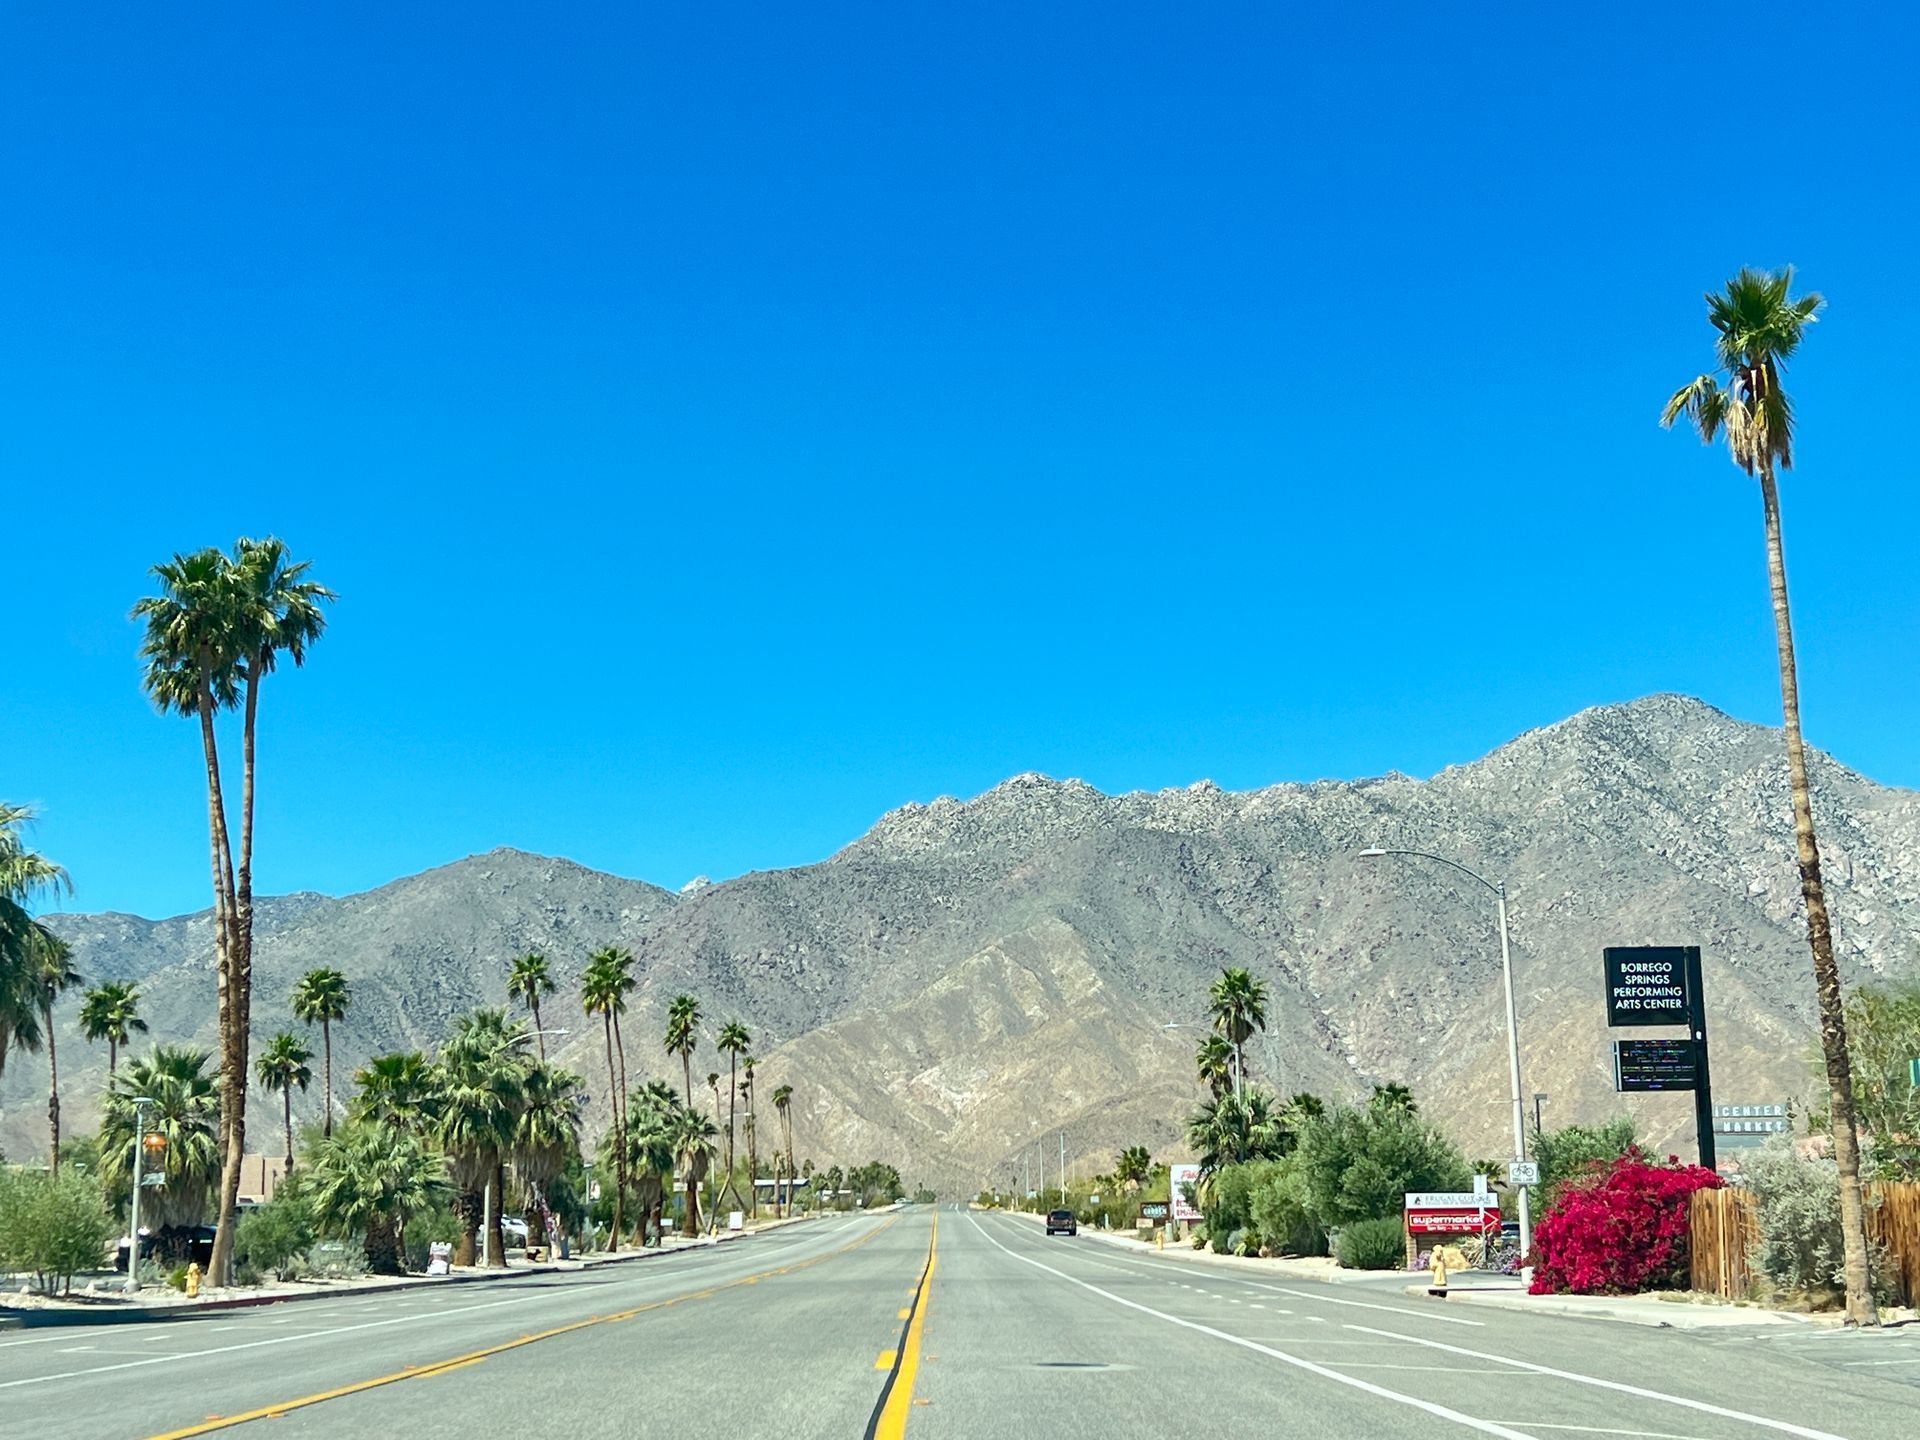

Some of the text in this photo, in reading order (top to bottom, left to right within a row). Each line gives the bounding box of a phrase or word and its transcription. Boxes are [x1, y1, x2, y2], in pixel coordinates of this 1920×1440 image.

[1620, 962, 1672, 973] BORREGO
[1625, 974, 1670, 985] SPRINGS
[1613, 986, 1683, 997] PERFORMING
[1615, 999, 1683, 1010] ARTS CENTER
[1723, 1121, 1782, 1132] MARKET
